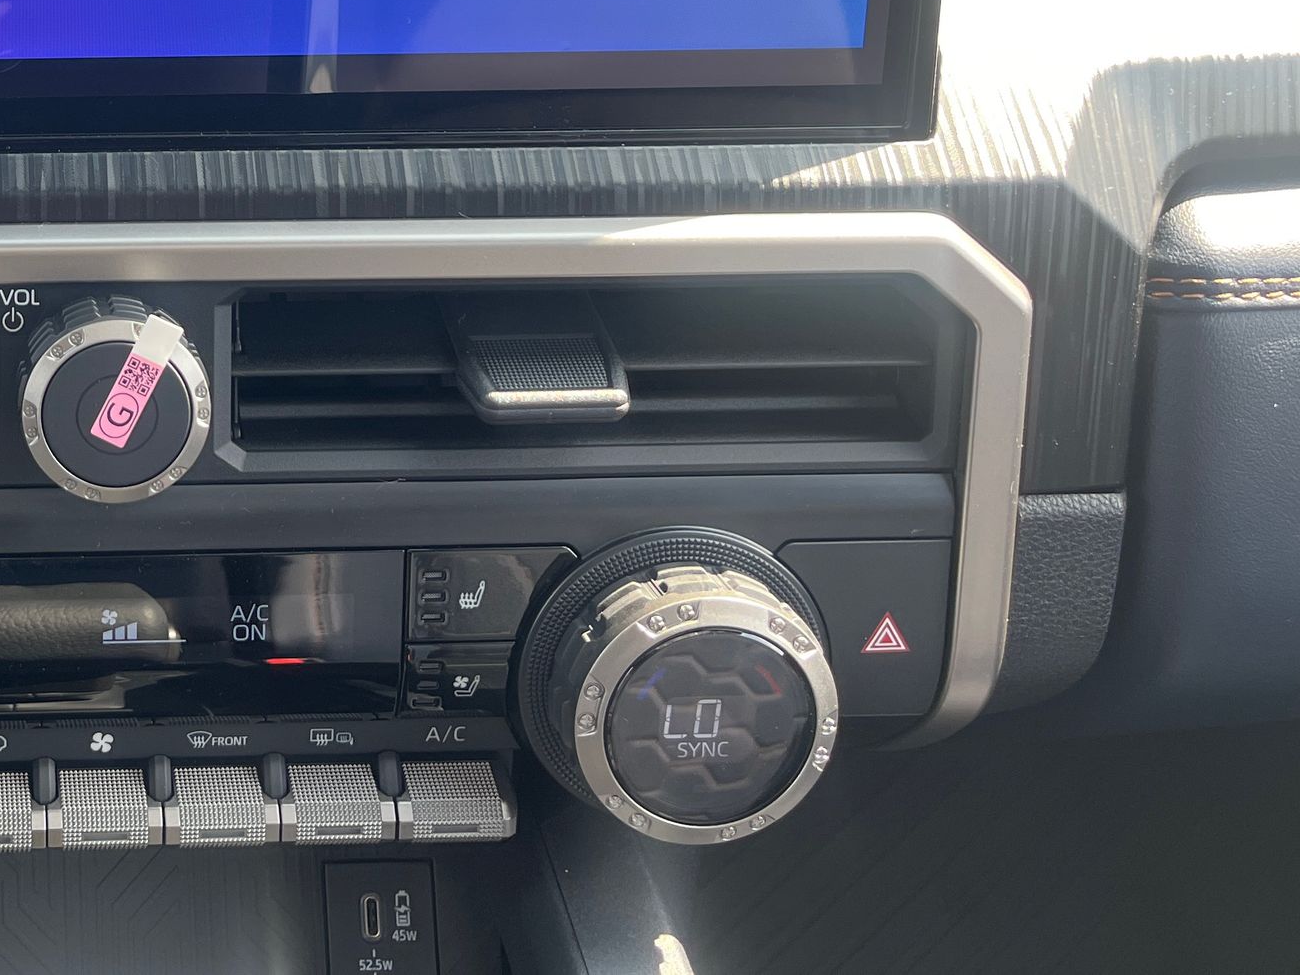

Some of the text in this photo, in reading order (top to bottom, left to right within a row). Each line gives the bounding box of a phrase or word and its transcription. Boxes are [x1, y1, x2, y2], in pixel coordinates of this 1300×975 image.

[0, 289, 40, 305] VOL
[107, 402, 134, 427] G
[231, 604, 269, 622] A/C
[233, 624, 266, 641] ON
[212, 735, 248, 746] FRONT
[425, 726, 466, 742] A/C
[677, 741, 729, 758] SYNC
[392, 930, 417, 941] 45W
[359, 960, 393, 971] 52.5W
